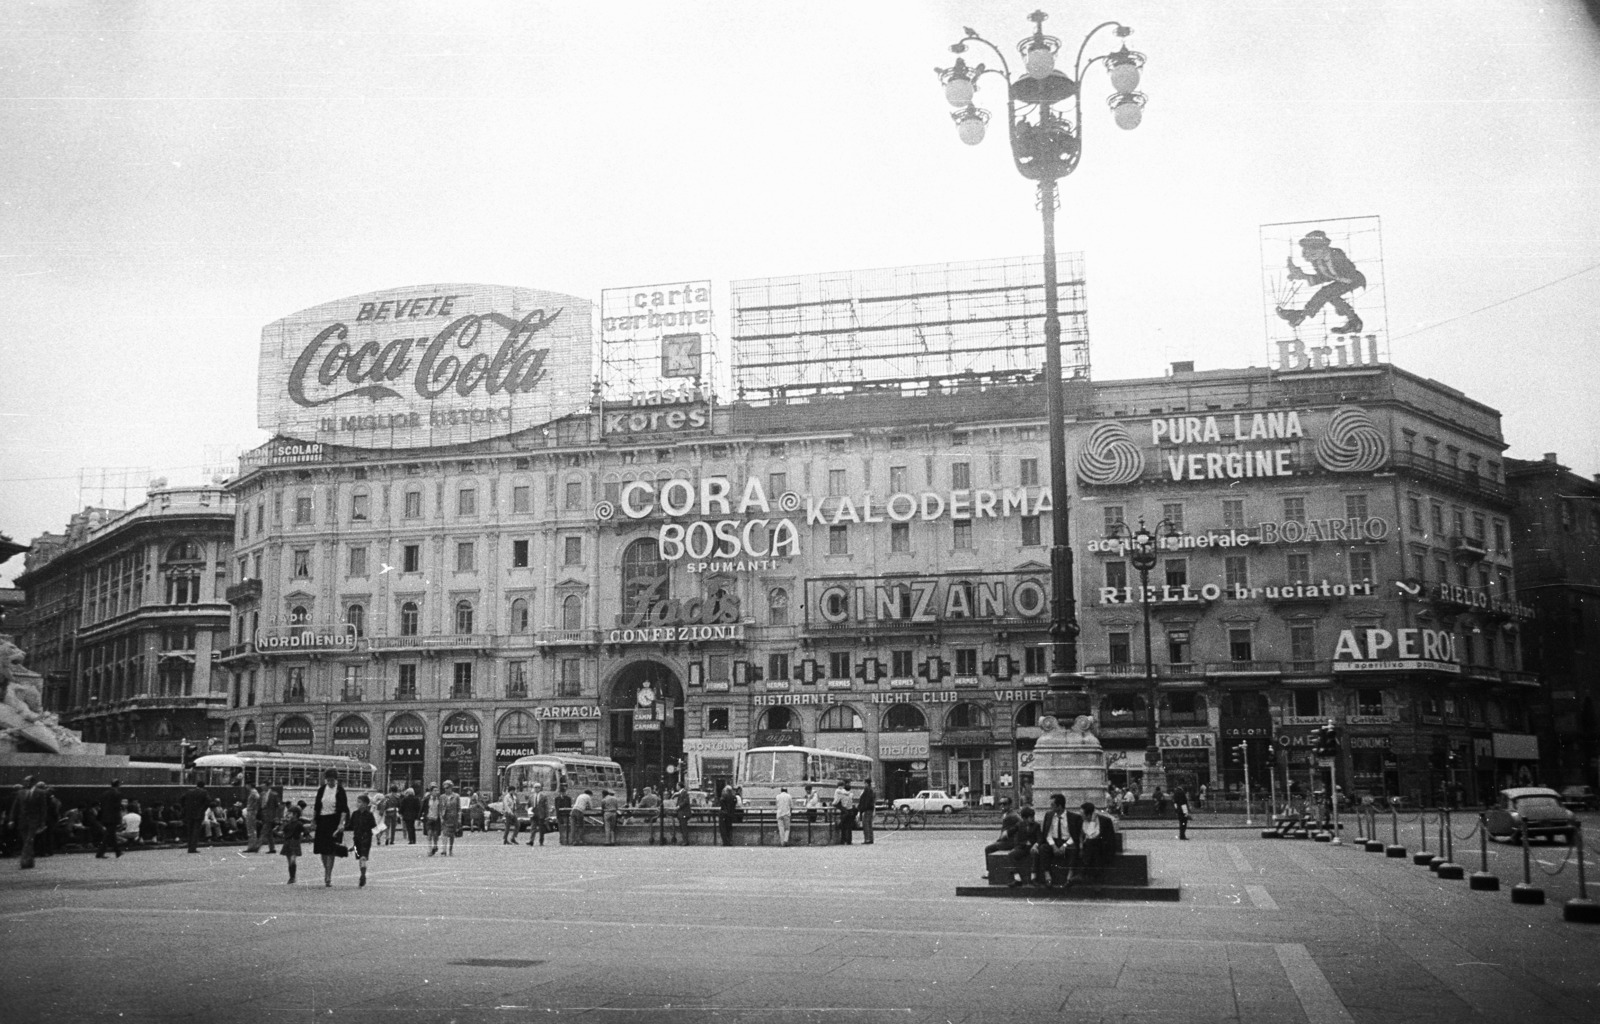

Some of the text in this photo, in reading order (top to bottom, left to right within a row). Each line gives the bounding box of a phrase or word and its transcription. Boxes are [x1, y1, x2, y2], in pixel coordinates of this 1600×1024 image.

[356, 295, 458, 322] BEVETE
[634, 284, 709, 309] carta
[603, 309, 709, 332] carbone
[288, 307, 563, 408] Coca-Cola
[668, 342, 696, 371] K
[1276, 334, 1378, 372] Brill
[632, 382, 710, 407] nastri
[341, 411, 420, 432] MIGLIOR
[430, 407, 512, 427] RISTORO
[1151, 410, 1304, 445] PURA LANA
[278, 444, 323, 456] SCOLARI
[1167, 449, 1294, 481] VERGINE
[620, 476, 771, 518] CORA
[807, 486, 1053, 525] KALODERMA
[658, 518, 801, 561] BOSCA
[1258, 517, 1388, 544] BOARIO
[686, 560, 777, 573] SPUMANTI
[819, 578, 1046, 623] CINZANO
[1098, 577, 1373, 605] RIELLO bruciatori
[1441, 583, 1487, 608] RIELLO
[610, 626, 737, 644] CONFEZIONI
[1333, 628, 1461, 663] APEROL
[754, 693, 835, 706] RISTORANTE
[871, 692, 912, 704] NIGHT
[922, 691, 958, 703] CLUB
[535, 706, 602, 718] FARMACIA
[444, 724, 479, 733] PITASSI
[1158, 734, 1213, 749] Kodak
[496, 748, 535, 757] FARMACIA
